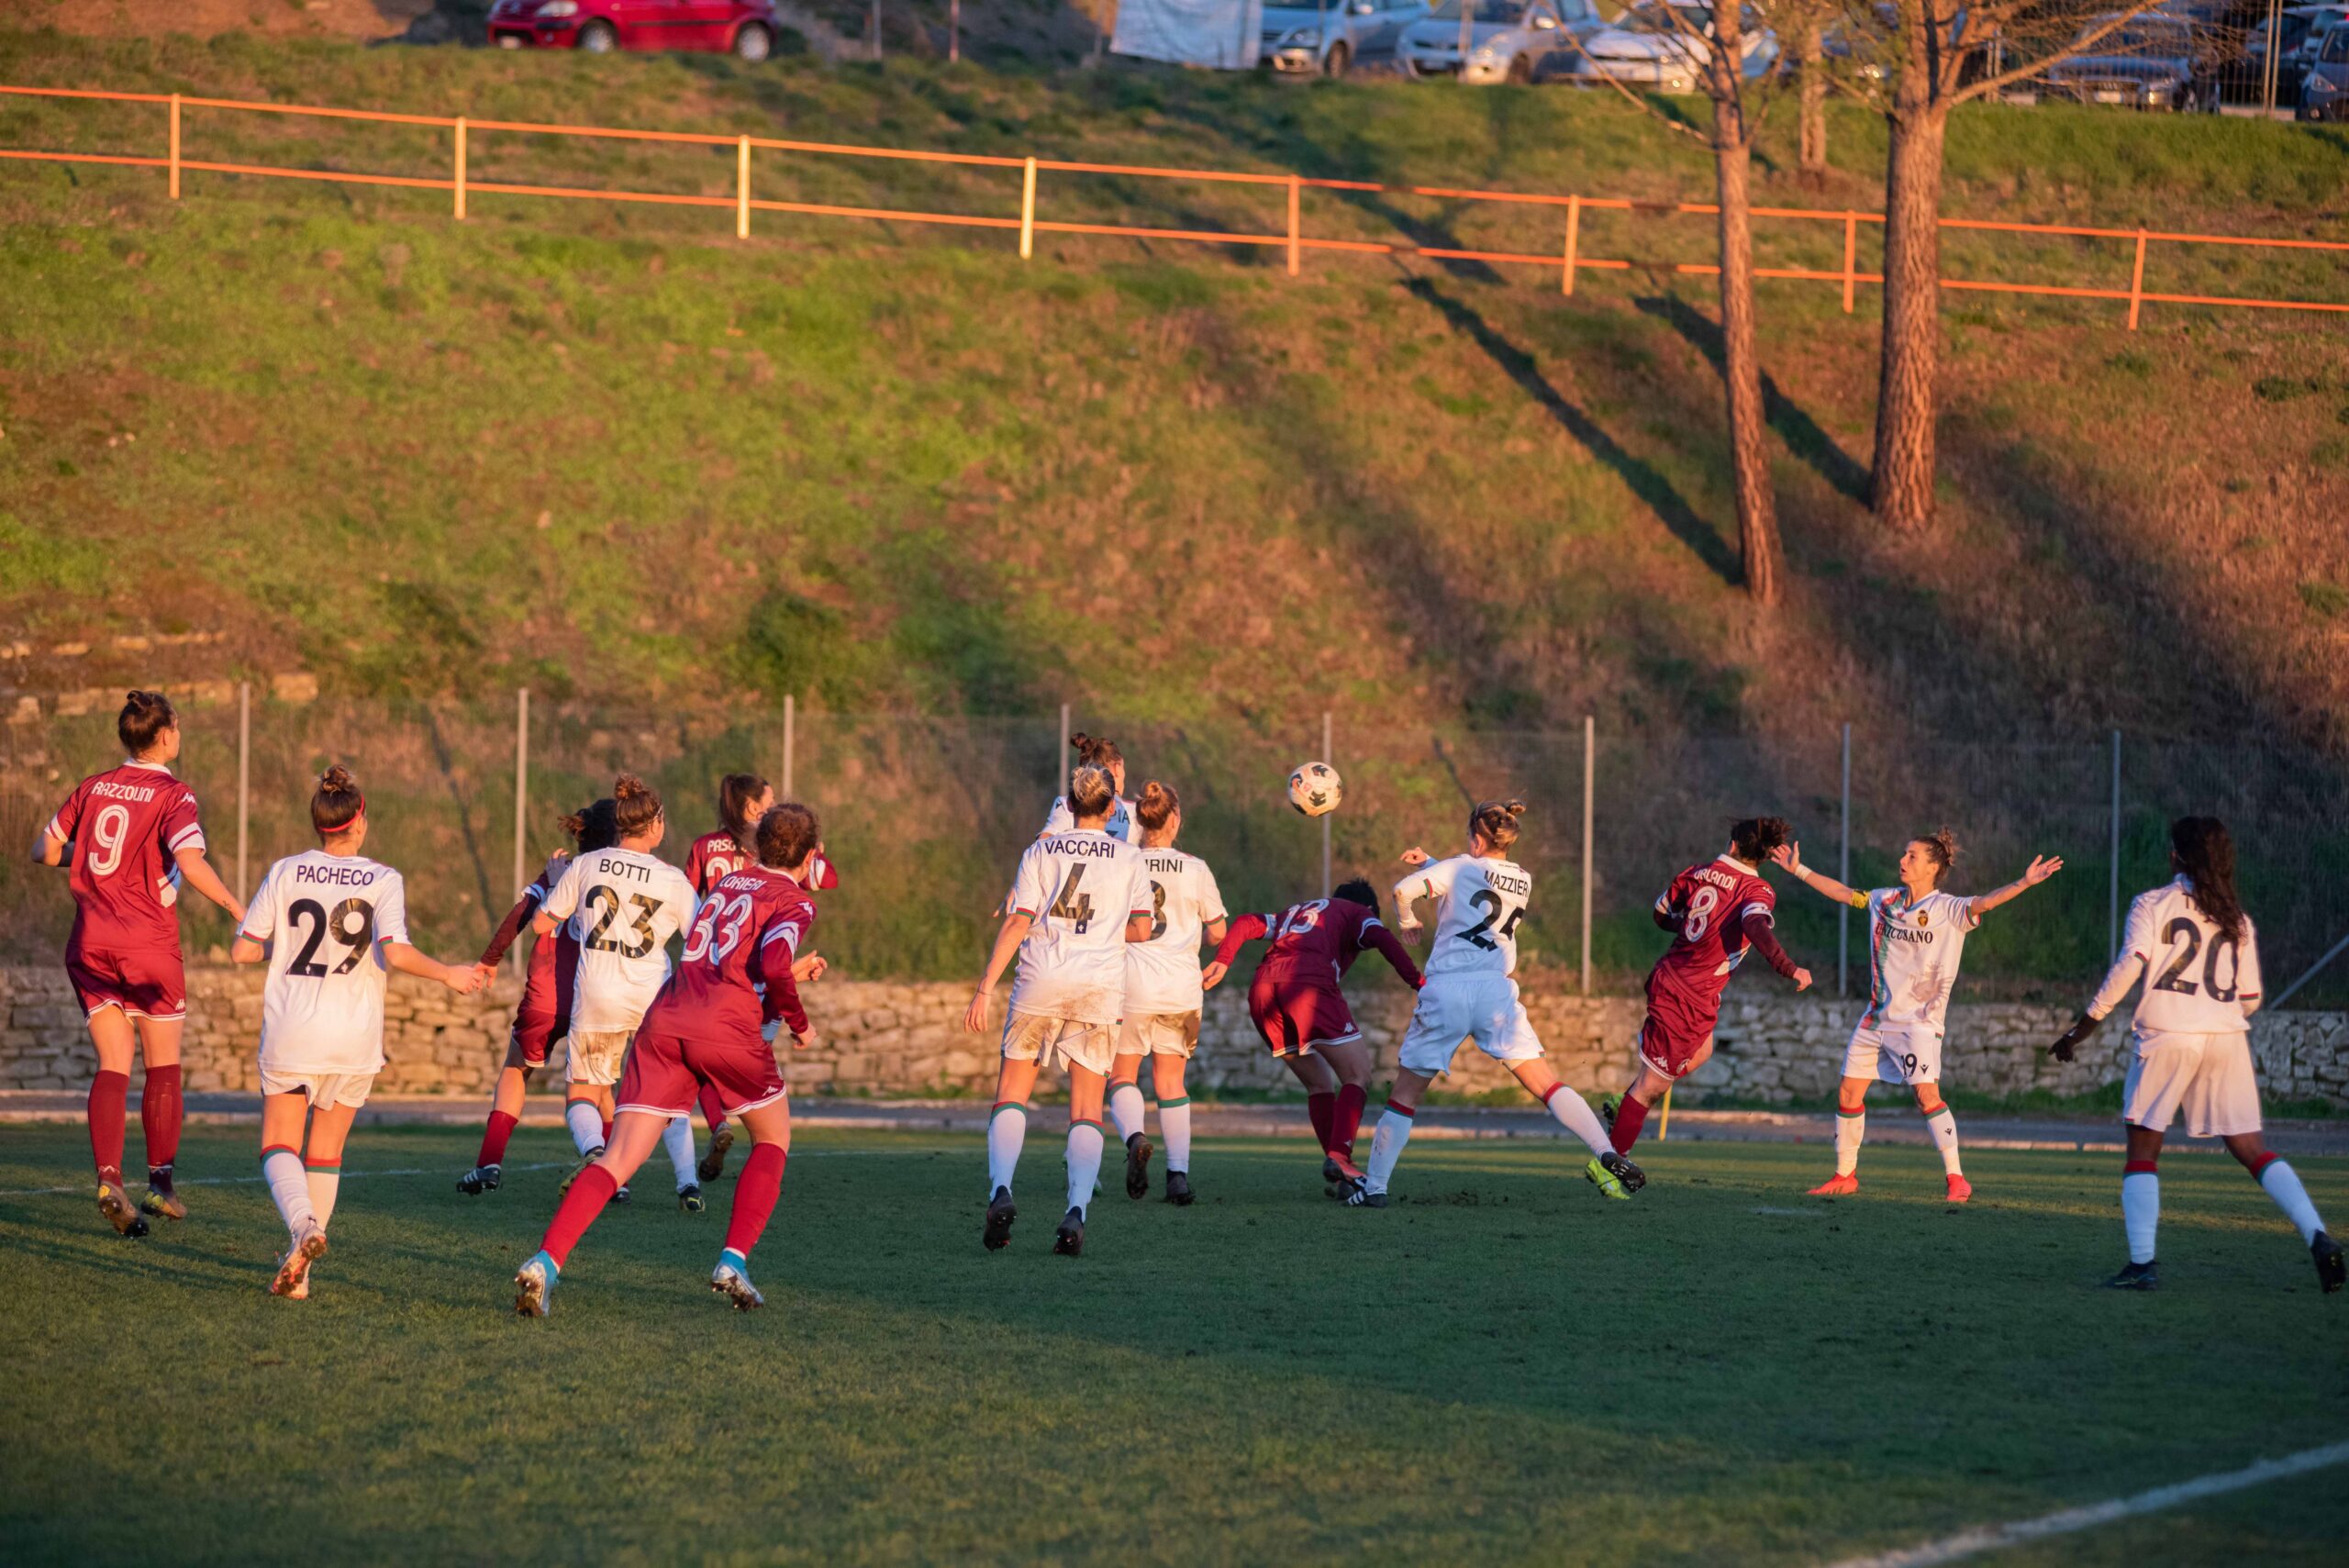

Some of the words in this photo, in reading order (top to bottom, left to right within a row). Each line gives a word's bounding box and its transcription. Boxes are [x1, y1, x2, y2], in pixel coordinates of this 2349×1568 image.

[89, 805, 128, 875] 9
[1045, 840, 1115, 859] VACCARI
[296, 865, 374, 885] PACHECO
[599, 859, 651, 883] BOTTI
[1145, 859, 1183, 873] RINI
[1484, 870, 1531, 897] MAZZIER
[584, 884, 664, 959] 23
[1050, 862, 1095, 934] 4
[1276, 898, 1330, 940] 13
[1685, 885, 1718, 942] 8
[285, 897, 374, 978] 29
[680, 892, 752, 966] 33
[2152, 917, 2239, 1003] 20
[1900, 1052, 1918, 1078] 19
